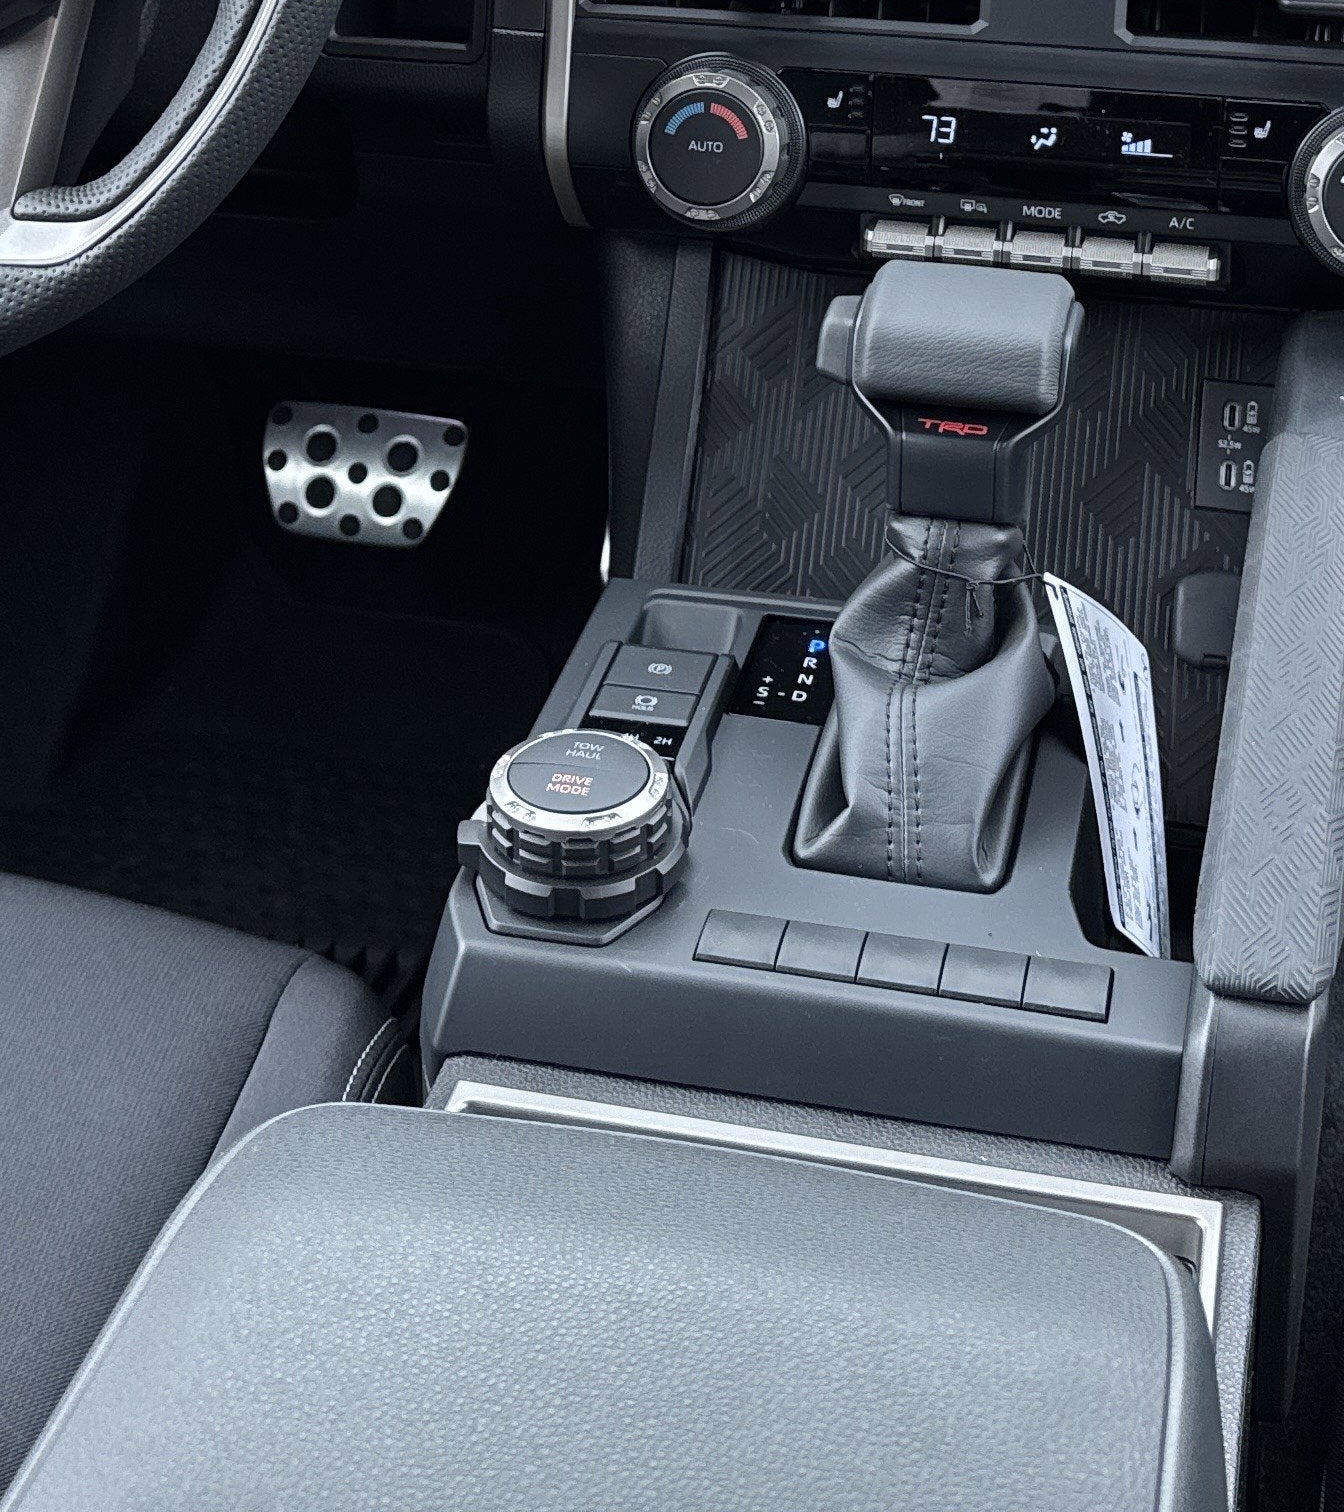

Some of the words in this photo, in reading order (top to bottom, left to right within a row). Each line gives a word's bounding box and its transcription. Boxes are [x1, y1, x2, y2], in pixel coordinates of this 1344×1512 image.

[921, 114, 957, 144] 73
[687, 139, 724, 153] AUTO
[903, 198, 925, 207] FRONT
[1022, 205, 1062, 220] MODE
[1168, 216, 1195, 231] A/C
[918, 418, 989, 436] TRD
[808, 639, 825, 653] P
[803, 657, 817, 669] R
[797, 673, 814, 685] N
[756, 686, 770, 698] S
[791, 690, 807, 702] D
[573, 741, 605, 752] TOW
[653, 736, 673, 746] 2H
[565, 749, 601, 760] HAUL
[551, 773, 594, 785] DRIVE
[545, 783, 591, 796] MODE
